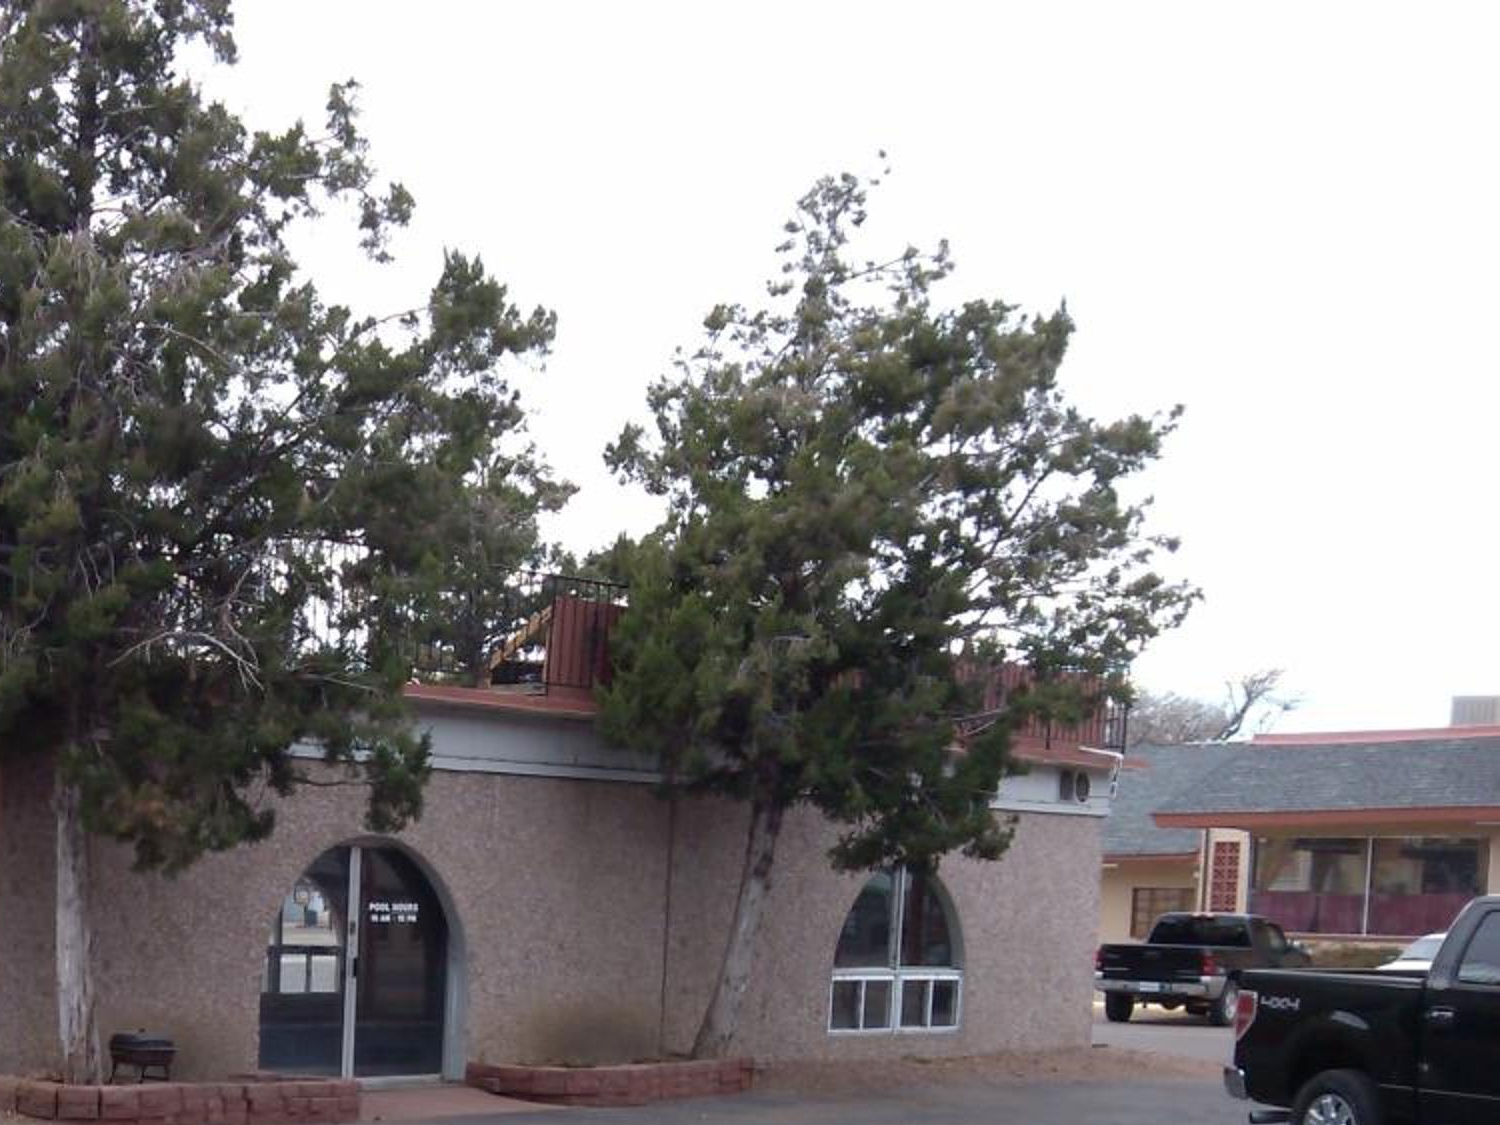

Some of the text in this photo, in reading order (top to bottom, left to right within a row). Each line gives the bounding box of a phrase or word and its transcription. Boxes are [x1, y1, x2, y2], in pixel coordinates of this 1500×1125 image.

[369, 902, 419, 912] POOL HOURS
[379, 914, 391, 923] AM
[407, 914, 417, 923] PM
